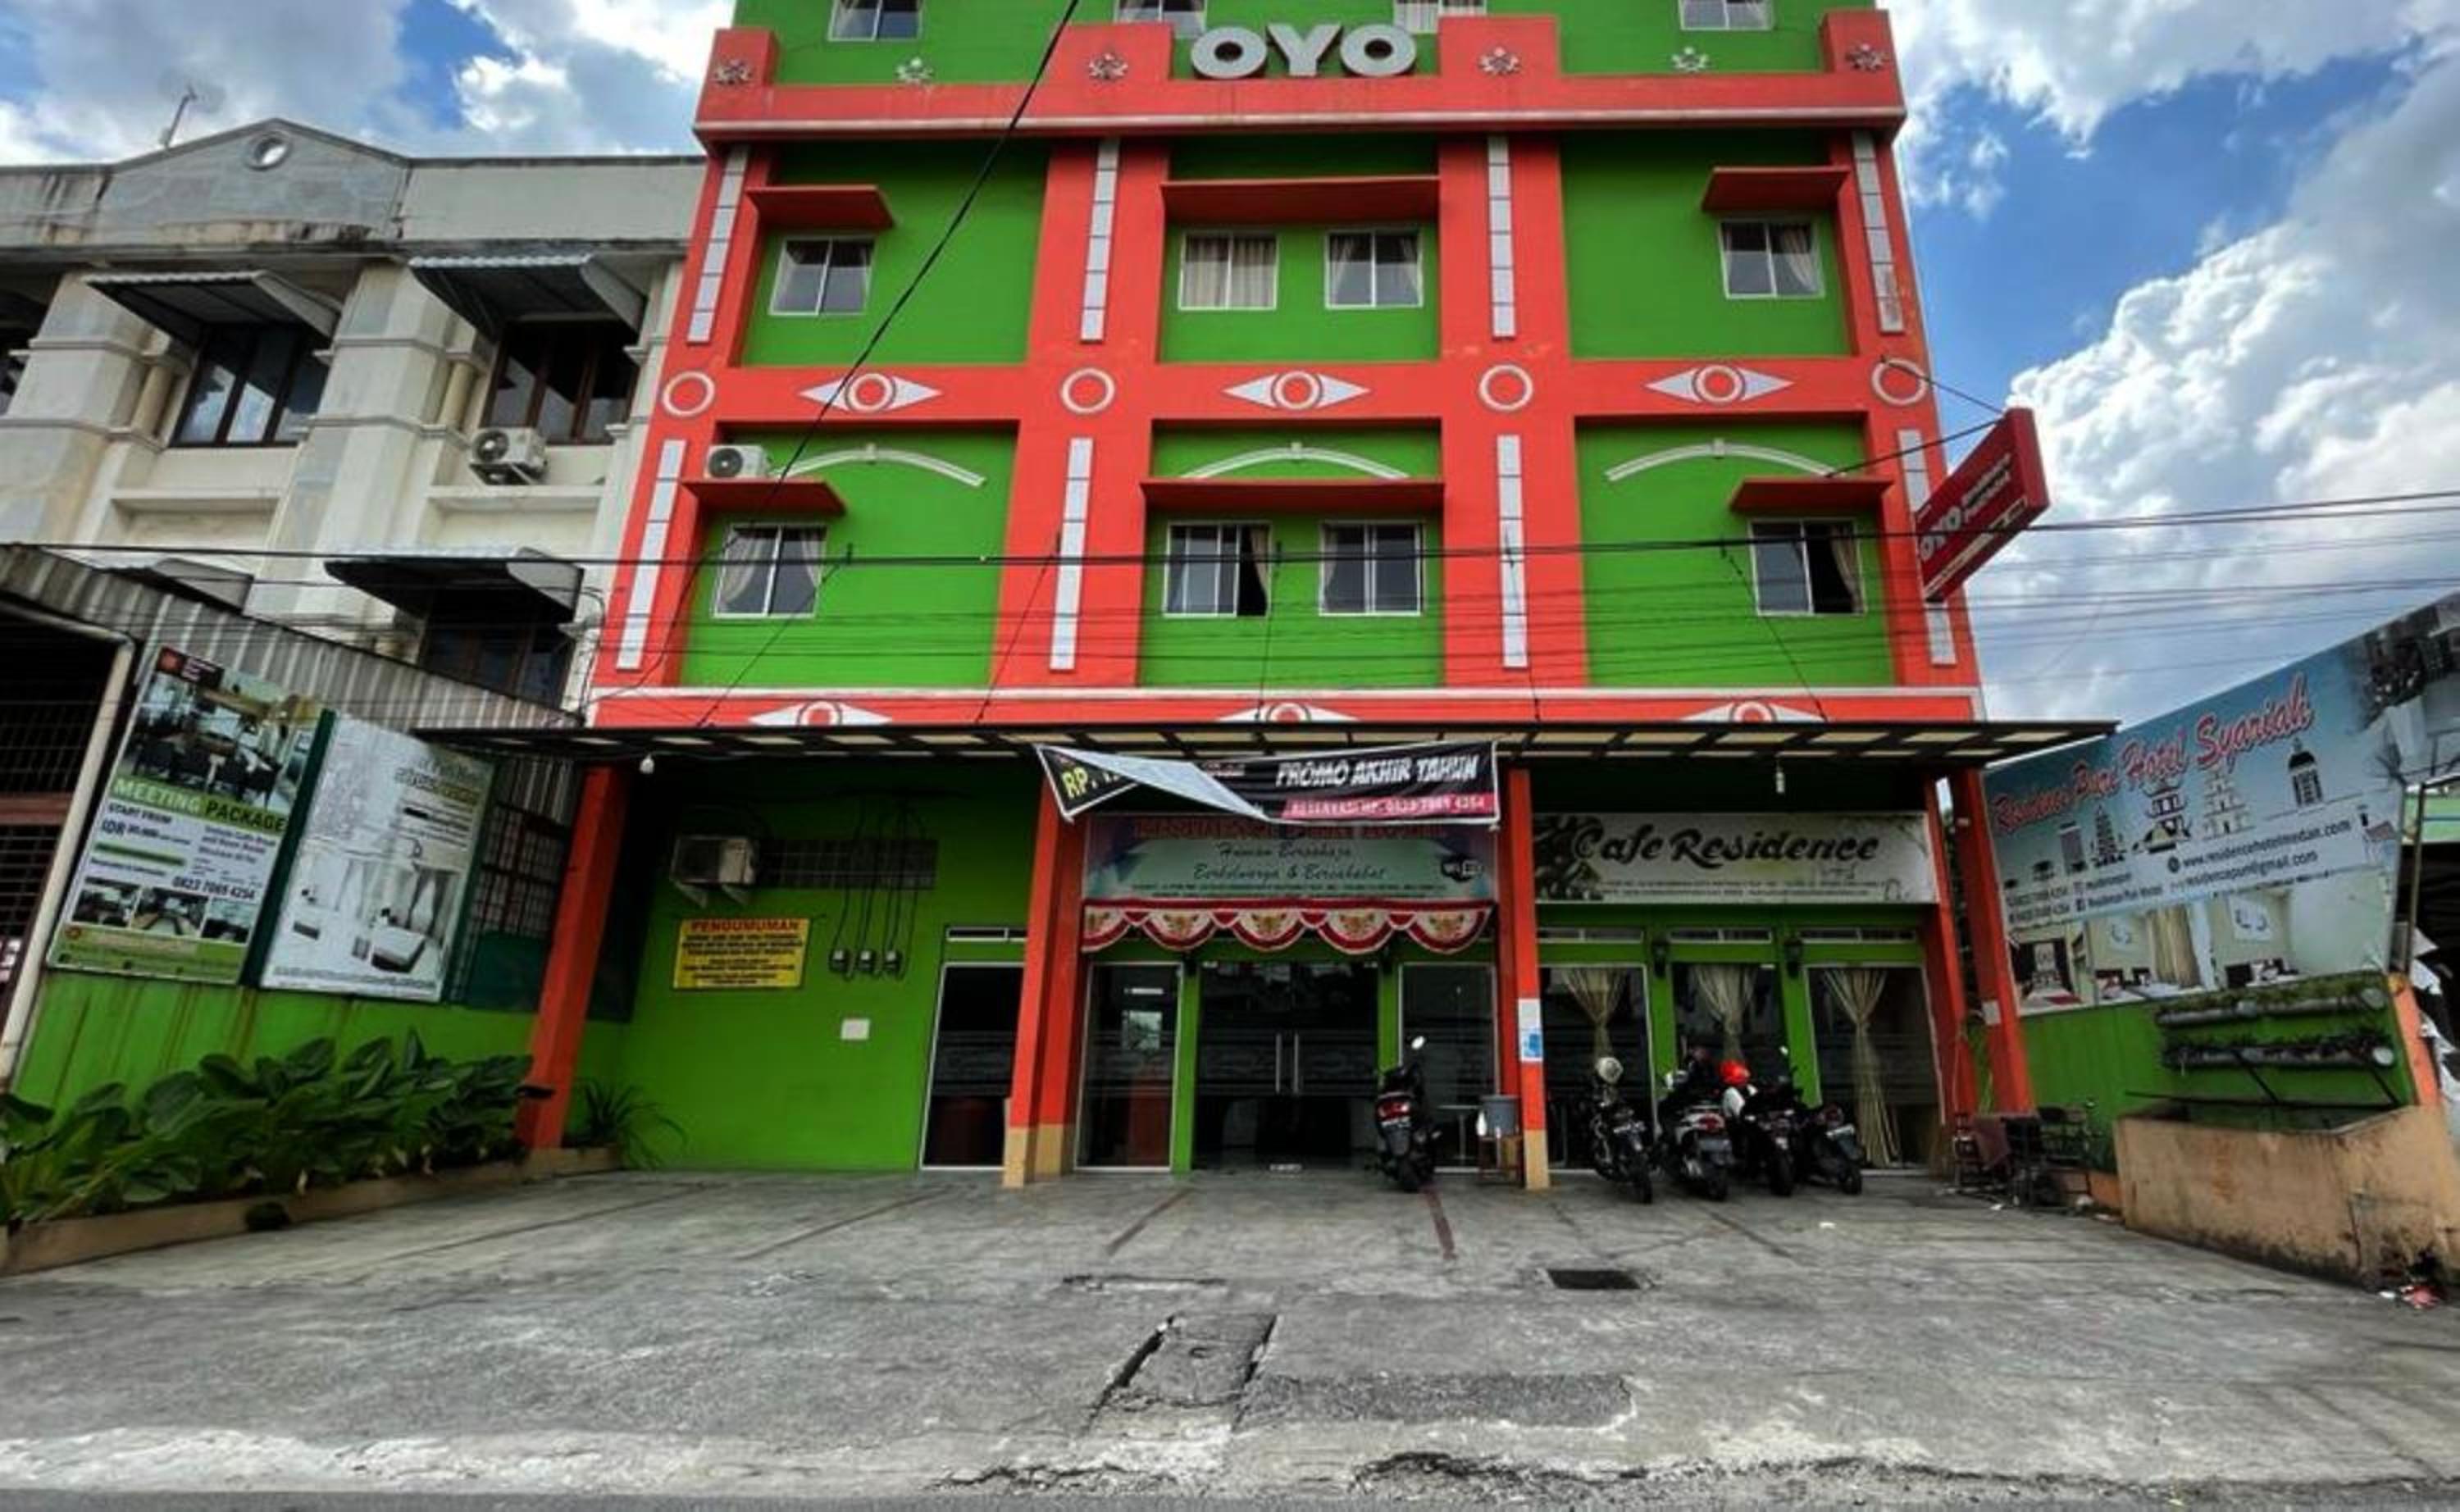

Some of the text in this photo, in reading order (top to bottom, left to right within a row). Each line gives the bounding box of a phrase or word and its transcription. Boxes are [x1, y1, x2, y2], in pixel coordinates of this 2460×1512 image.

[1191, 22, 1417, 80] OYO
[2120, 727, 2188, 783] Hotel
[2195, 672, 2315, 772] Syariah
[1275, 760, 1350, 788] PROMO
[1351, 756, 1412, 785] AKHIR
[1416, 754, 1481, 782] TAHUN
[112, 778, 287, 833] MEETING PACKAGE
[1572, 823, 1879, 870] Cafe Residence
